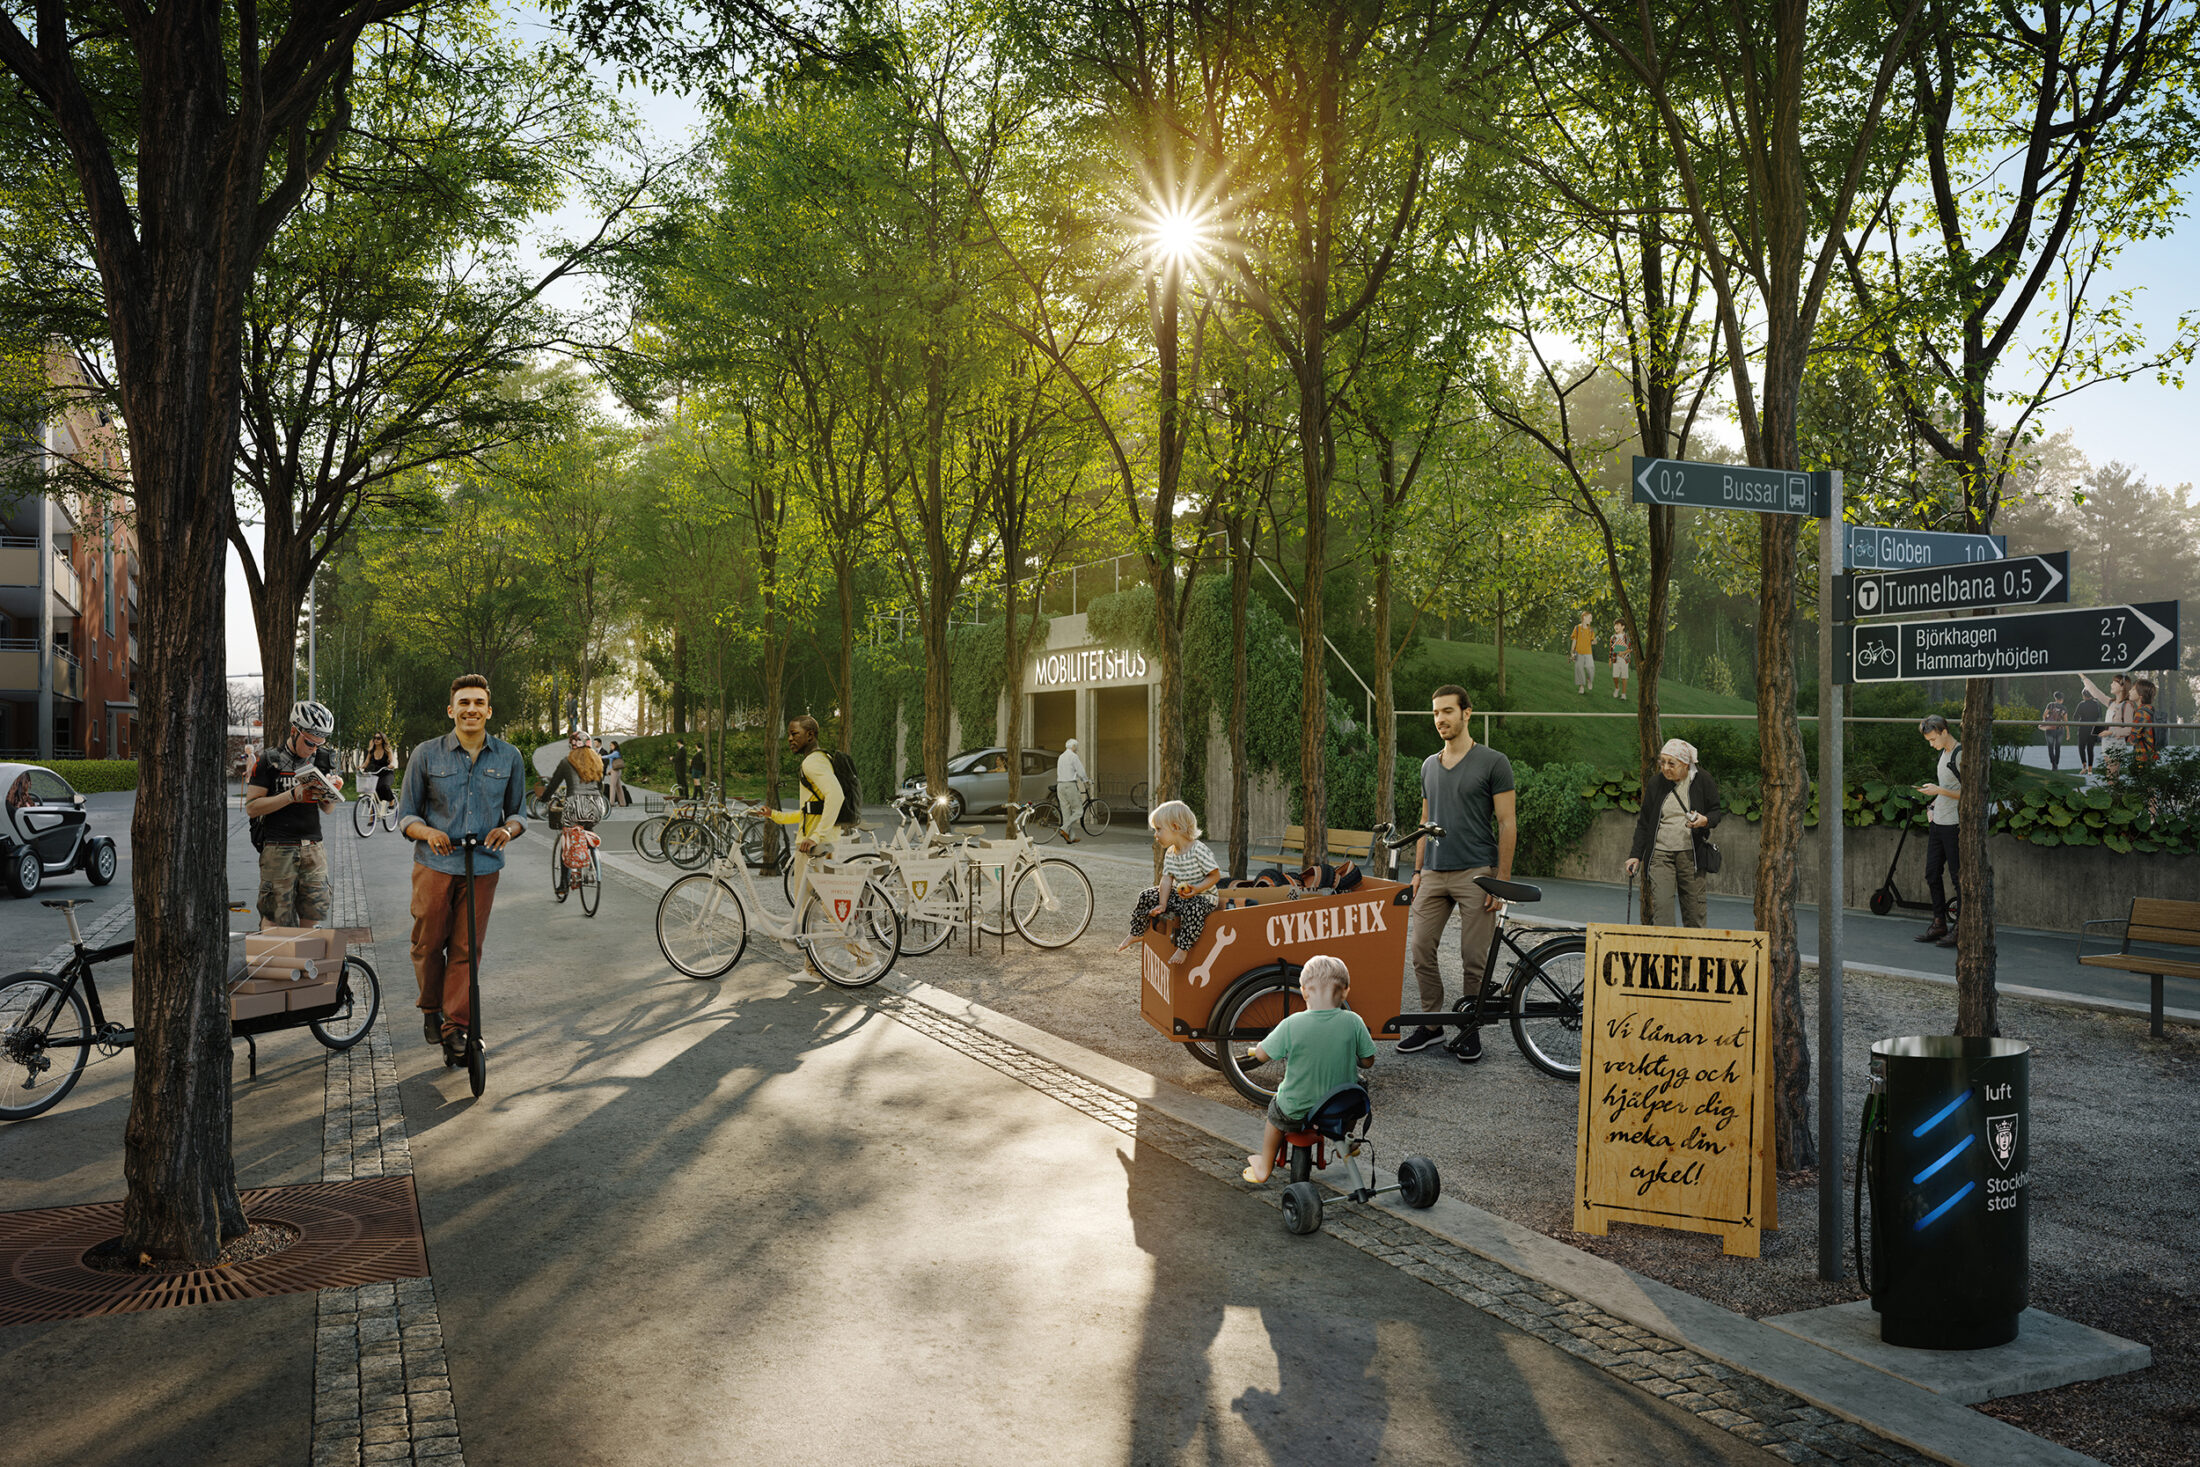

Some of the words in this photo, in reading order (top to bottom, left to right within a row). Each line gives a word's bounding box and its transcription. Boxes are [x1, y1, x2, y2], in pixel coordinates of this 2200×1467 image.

[1660, 469, 1685, 499] 0,2
[1723, 475, 1779, 503] Bussar
[1881, 536, 1932, 564] Globen
[1965, 544, 1985, 562] 10
[1885, 575, 1996, 606] Tunnelbana
[2004, 569, 2032, 598] 0,5
[1916, 627, 1997, 648] Björkhagen
[2101, 617, 2126, 638] 2,7
[1035, 647, 1146, 685] MOBILITETSHUS
[1916, 647, 2049, 671] Hammarbyhöjden
[2101, 643, 2128, 664] 2,3
[1266, 900, 1387, 947] CYKELFIX
[1603, 951, 1748, 996] CYKELFIX
[1607, 1012, 1638, 1039] Vi
[1638, 1017, 1708, 1046] lånar
[1714, 1026, 1751, 1048] ut
[1603, 1053, 1690, 1094] verktyg
[1695, 1060, 1739, 1083] och
[1602, 1083, 1688, 1123] hjälper
[1694, 1092, 1739, 1130] dig
[1986, 1083, 2012, 1101] luft
[1609, 1124, 1675, 1148] meka
[1680, 1128, 1727, 1155] din
[1629, 1157, 1705, 1196] cykel!
[1987, 1191, 2017, 1212] stad
